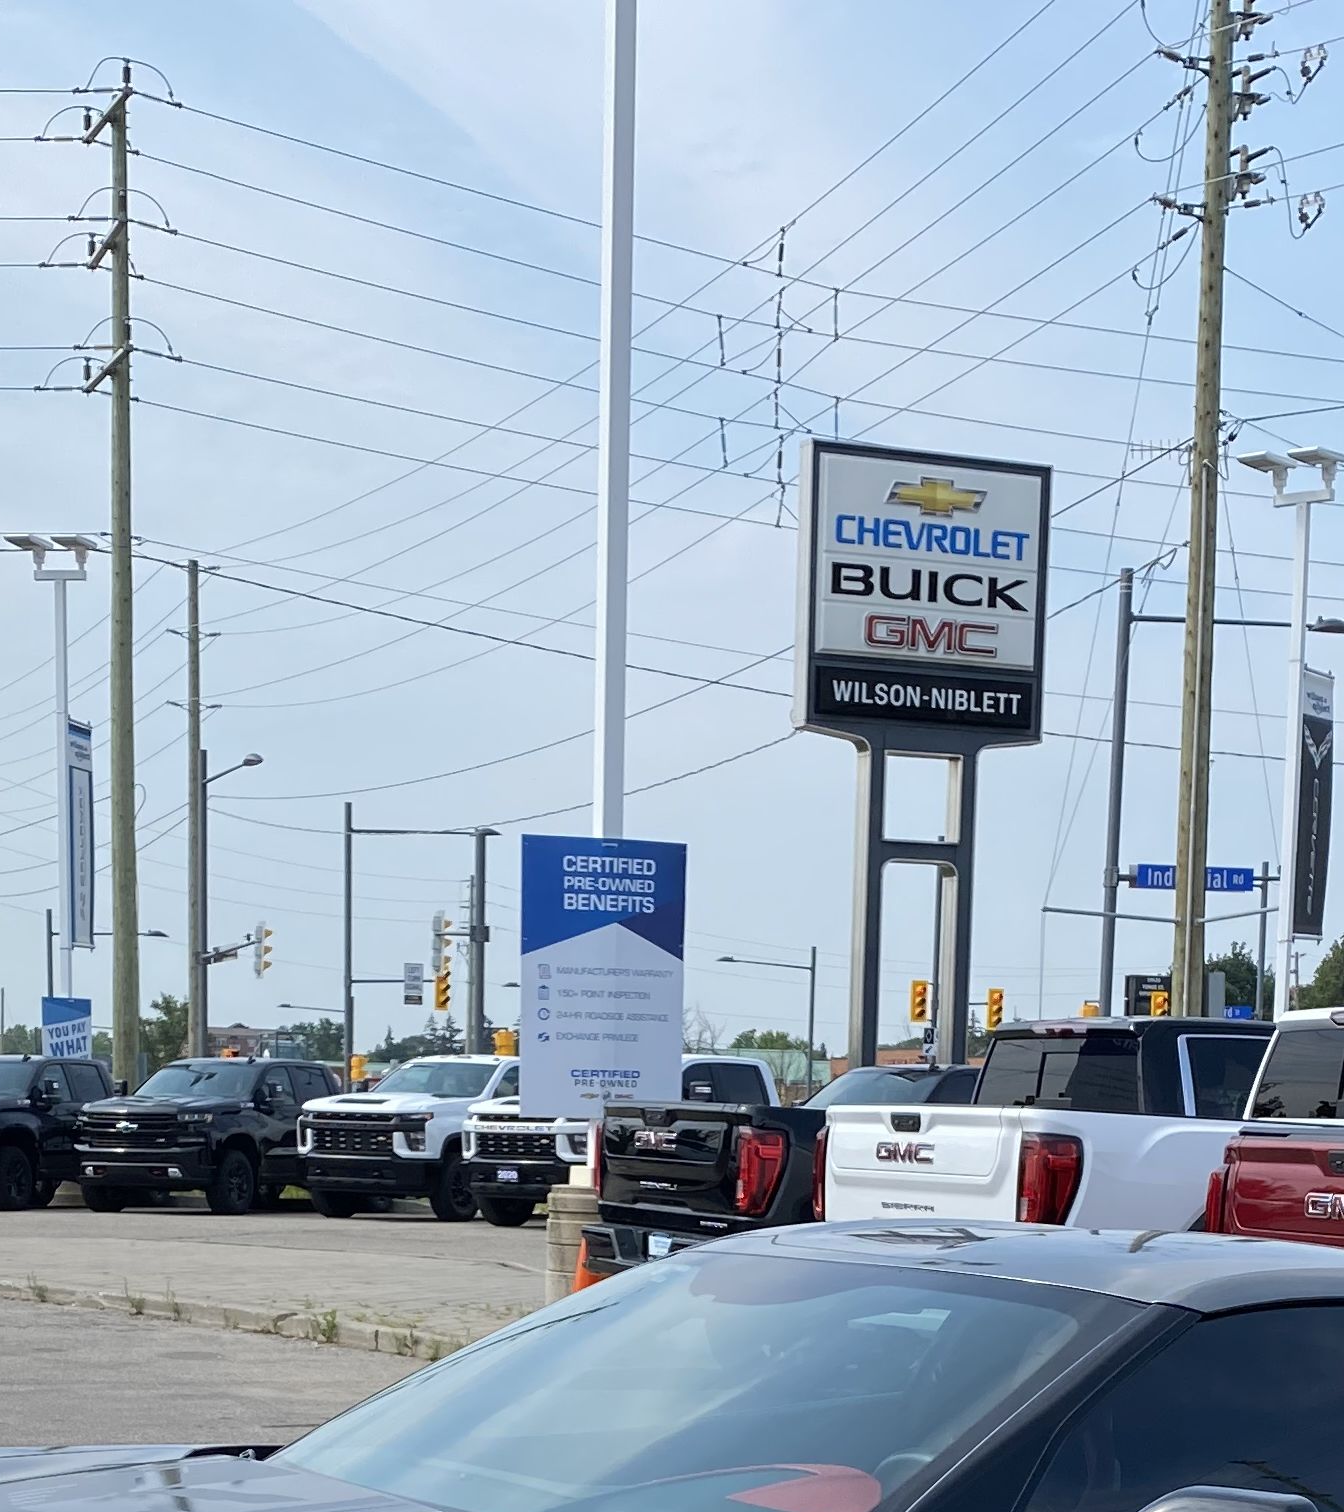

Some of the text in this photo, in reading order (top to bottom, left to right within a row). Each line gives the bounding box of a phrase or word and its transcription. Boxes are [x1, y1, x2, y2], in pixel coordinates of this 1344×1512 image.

[835, 514, 1030, 561] CHEVROLET
[830, 561, 1029, 612] BUICK
[864, 611, 999, 657] GMC
[832, 679, 1022, 715] WILSON-NIBLETT
[562, 855, 656, 876] CERTIFIED
[563, 876, 655, 893] PRE-OWNED
[1147, 867, 1244, 889] Indial Rd
[563, 893, 655, 914] BENEFITS
[581, 990, 605, 999] POINT
[607, 990, 651, 1001] INSPECTION
[585, 1011, 624, 1021] ROADSIDE
[47, 1020, 86, 1039] YOU PAY
[49, 1035, 88, 1057] WHAT
[571, 1069, 641, 1079] CERTIFIED
[876, 1141, 935, 1165] GMC
